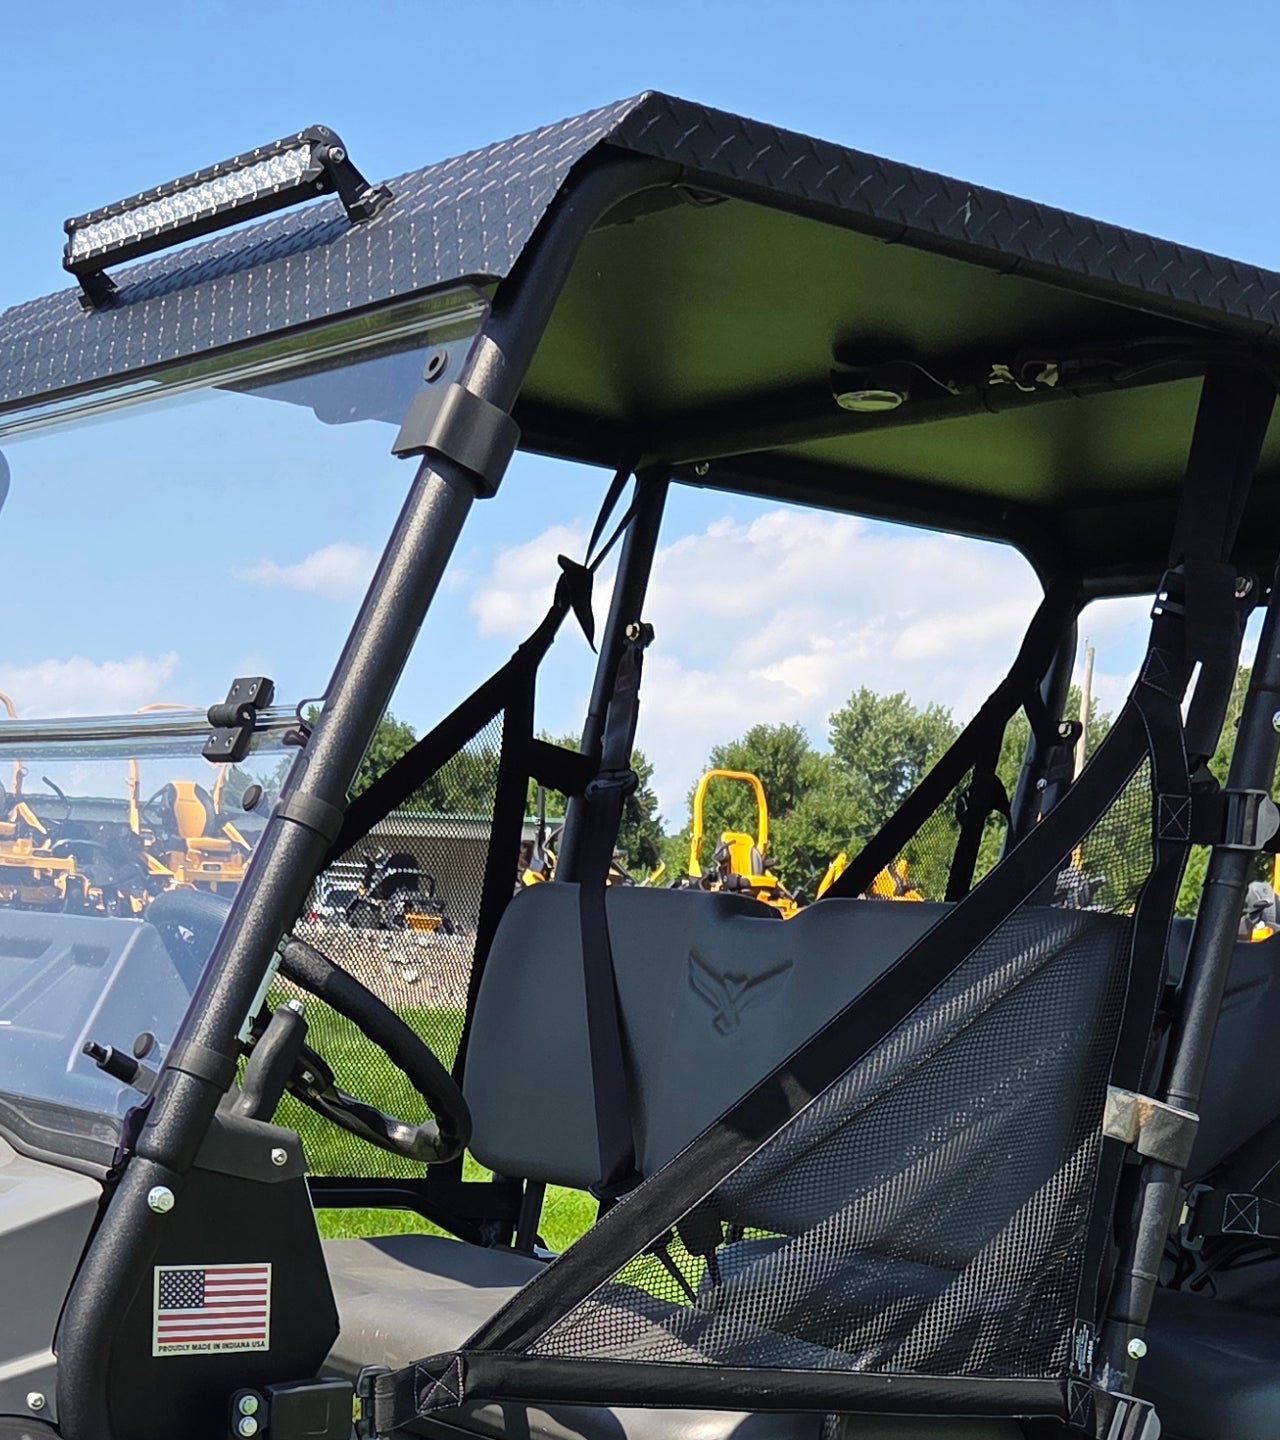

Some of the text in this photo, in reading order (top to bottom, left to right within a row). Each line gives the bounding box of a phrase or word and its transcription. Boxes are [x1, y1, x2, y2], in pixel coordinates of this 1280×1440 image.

[158, 1340, 265, 1352] PROUDLY MADE IN INDIANA USA
